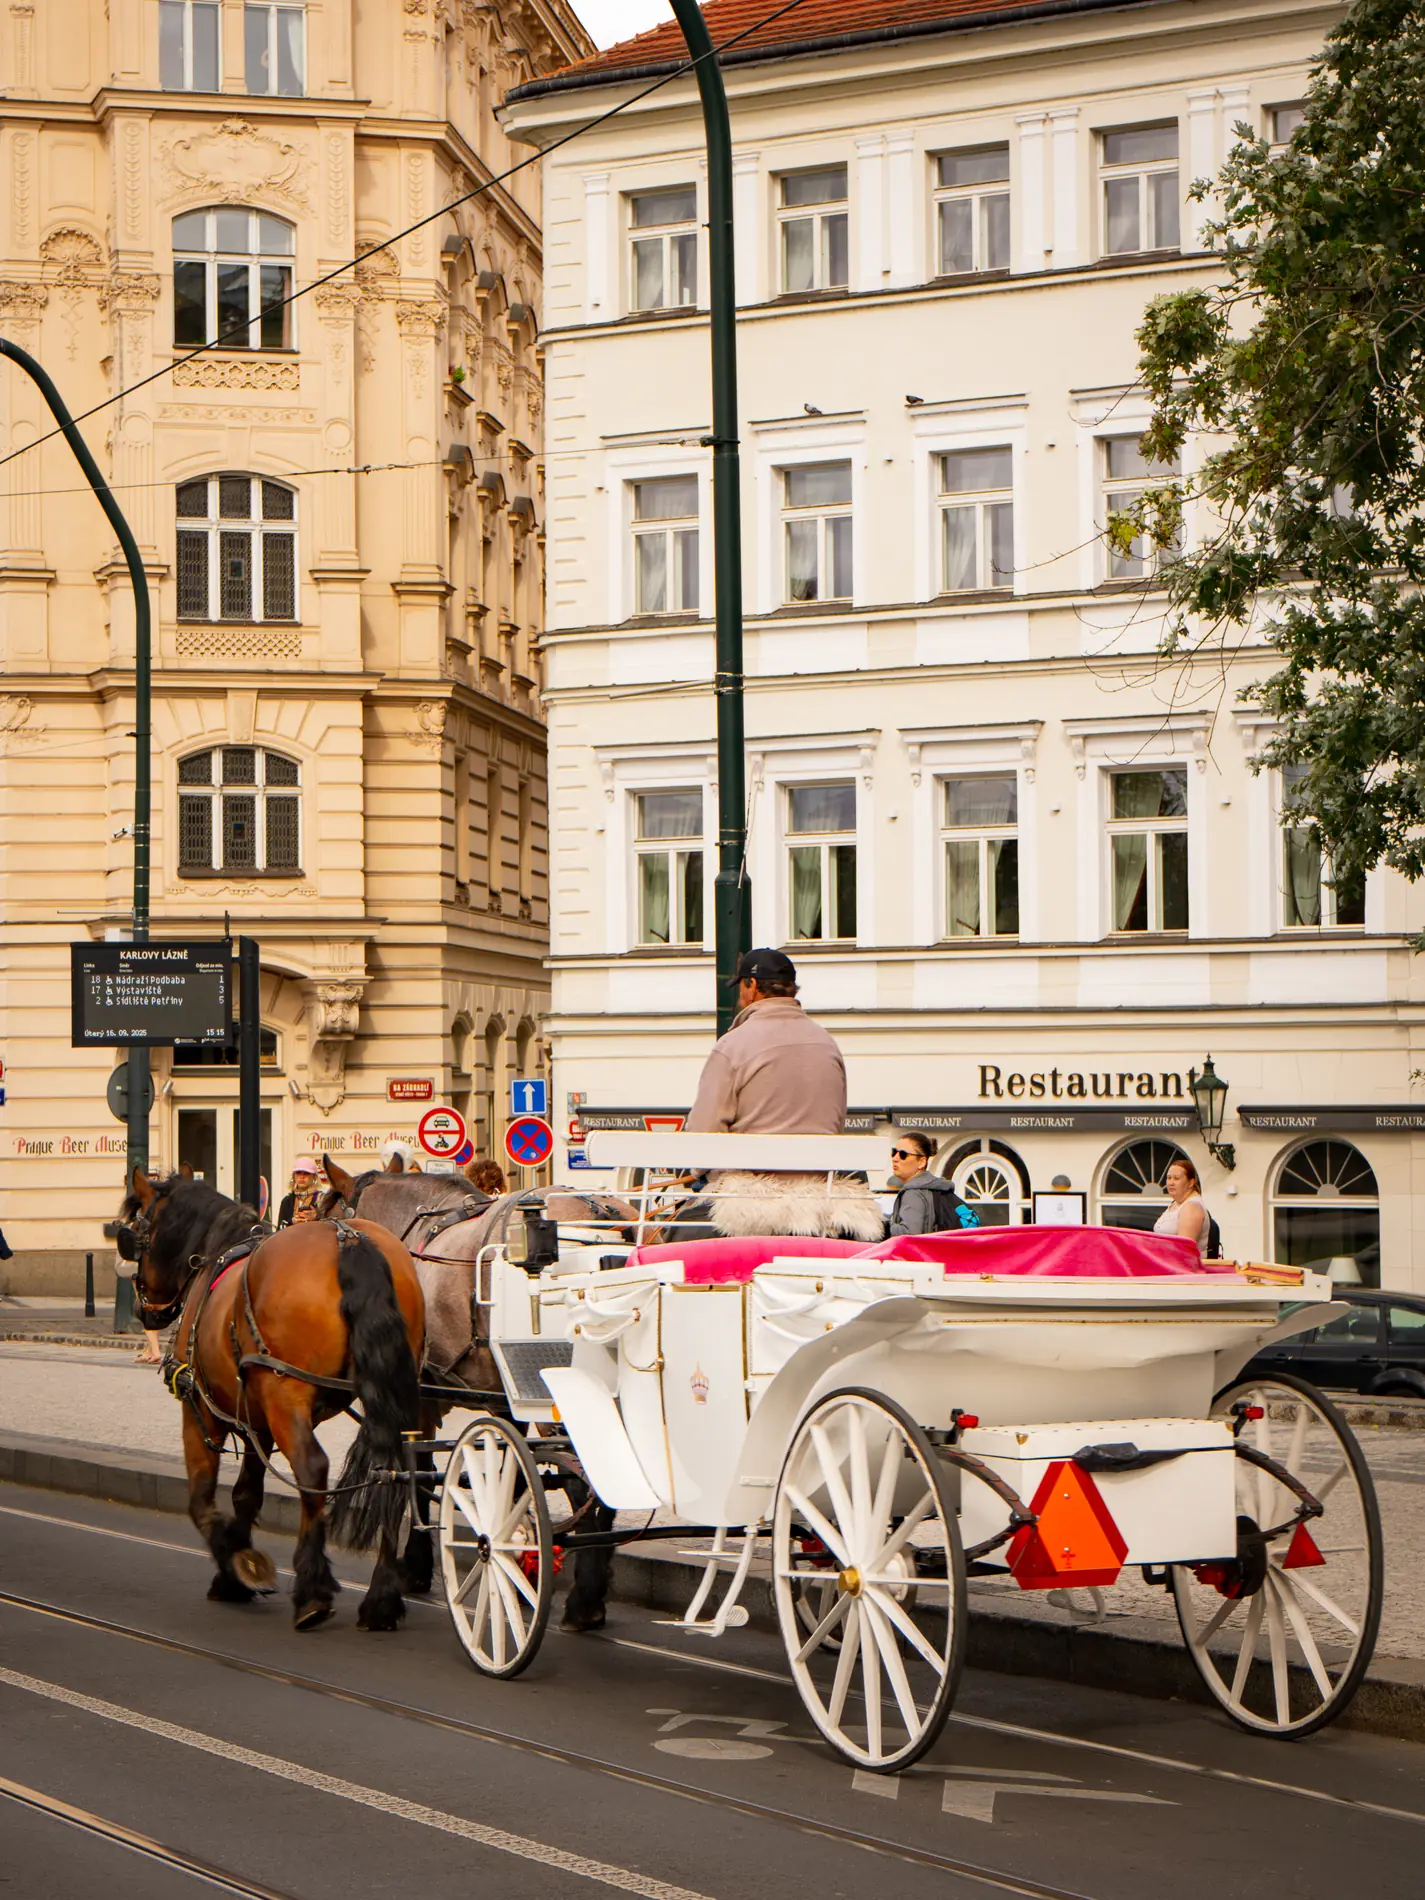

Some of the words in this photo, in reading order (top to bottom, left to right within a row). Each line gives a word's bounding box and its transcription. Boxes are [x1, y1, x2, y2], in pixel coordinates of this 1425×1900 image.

[119, 951, 160, 960] KARLOVY
[161, 949, 189, 960] LÁZNĚ
[91, 975, 101, 984] 18
[115, 975, 149, 985] Nádraží
[150, 975, 186, 985] Podbaba
[219, 976, 224, 984] 1
[91, 985, 101, 994] 17
[115, 985, 162, 996] Výstaviště
[219, 985, 225, 994] 3
[95, 996, 101, 1005] 2
[116, 996, 149, 1006] Sídliště
[151, 996, 183, 1006] Petřiny
[219, 996, 225, 1004] 5
[84, 1029, 105, 1038] Úterý
[106, 1029, 117, 1037] 16.
[118, 1029, 129, 1037] 09.
[131, 1029, 148, 1037] 2025
[977, 1064, 1201, 1099] Restaurant
[583, 1116, 641, 1128] RESTAURANT
[899, 1116, 963, 1128] RESTAURANT
[1010, 1116, 1075, 1128] RESTAURANT
[1124, 1115, 1190, 1127] RESTAURANT
[1249, 1116, 1317, 1127] RESTAURANT
[12, 1136, 54, 1156] Prague
[59, 1135, 90, 1154] Beer
[94, 1135, 128, 1154] Muse
[306, 1131, 346, 1152] Prague
[349, 1130, 381, 1150] Beer
